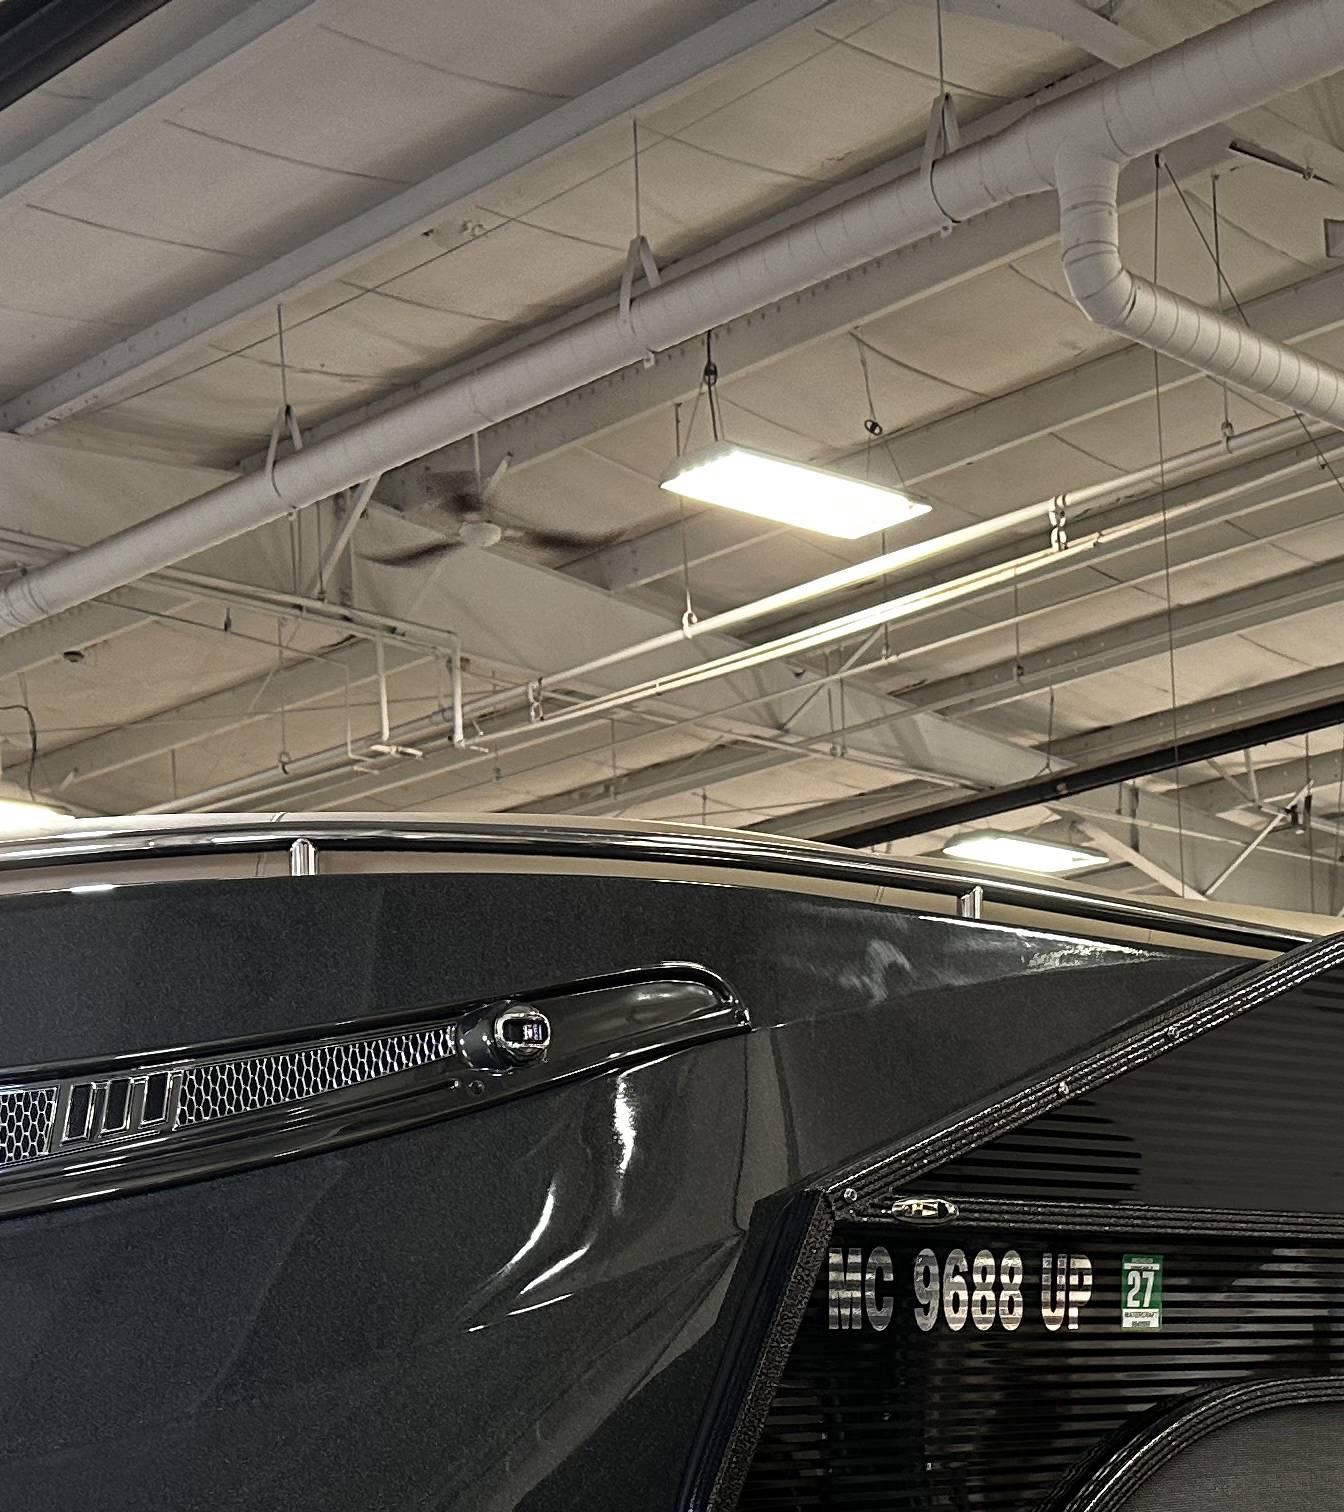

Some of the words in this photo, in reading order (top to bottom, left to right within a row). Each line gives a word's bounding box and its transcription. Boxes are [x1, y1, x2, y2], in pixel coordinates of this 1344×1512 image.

[828, 1246, 894, 1331] MC
[913, 1247, 1024, 1331] 9688
[1040, 1252, 1094, 1331] UP
[1126, 1270, 1155, 1308] 27
